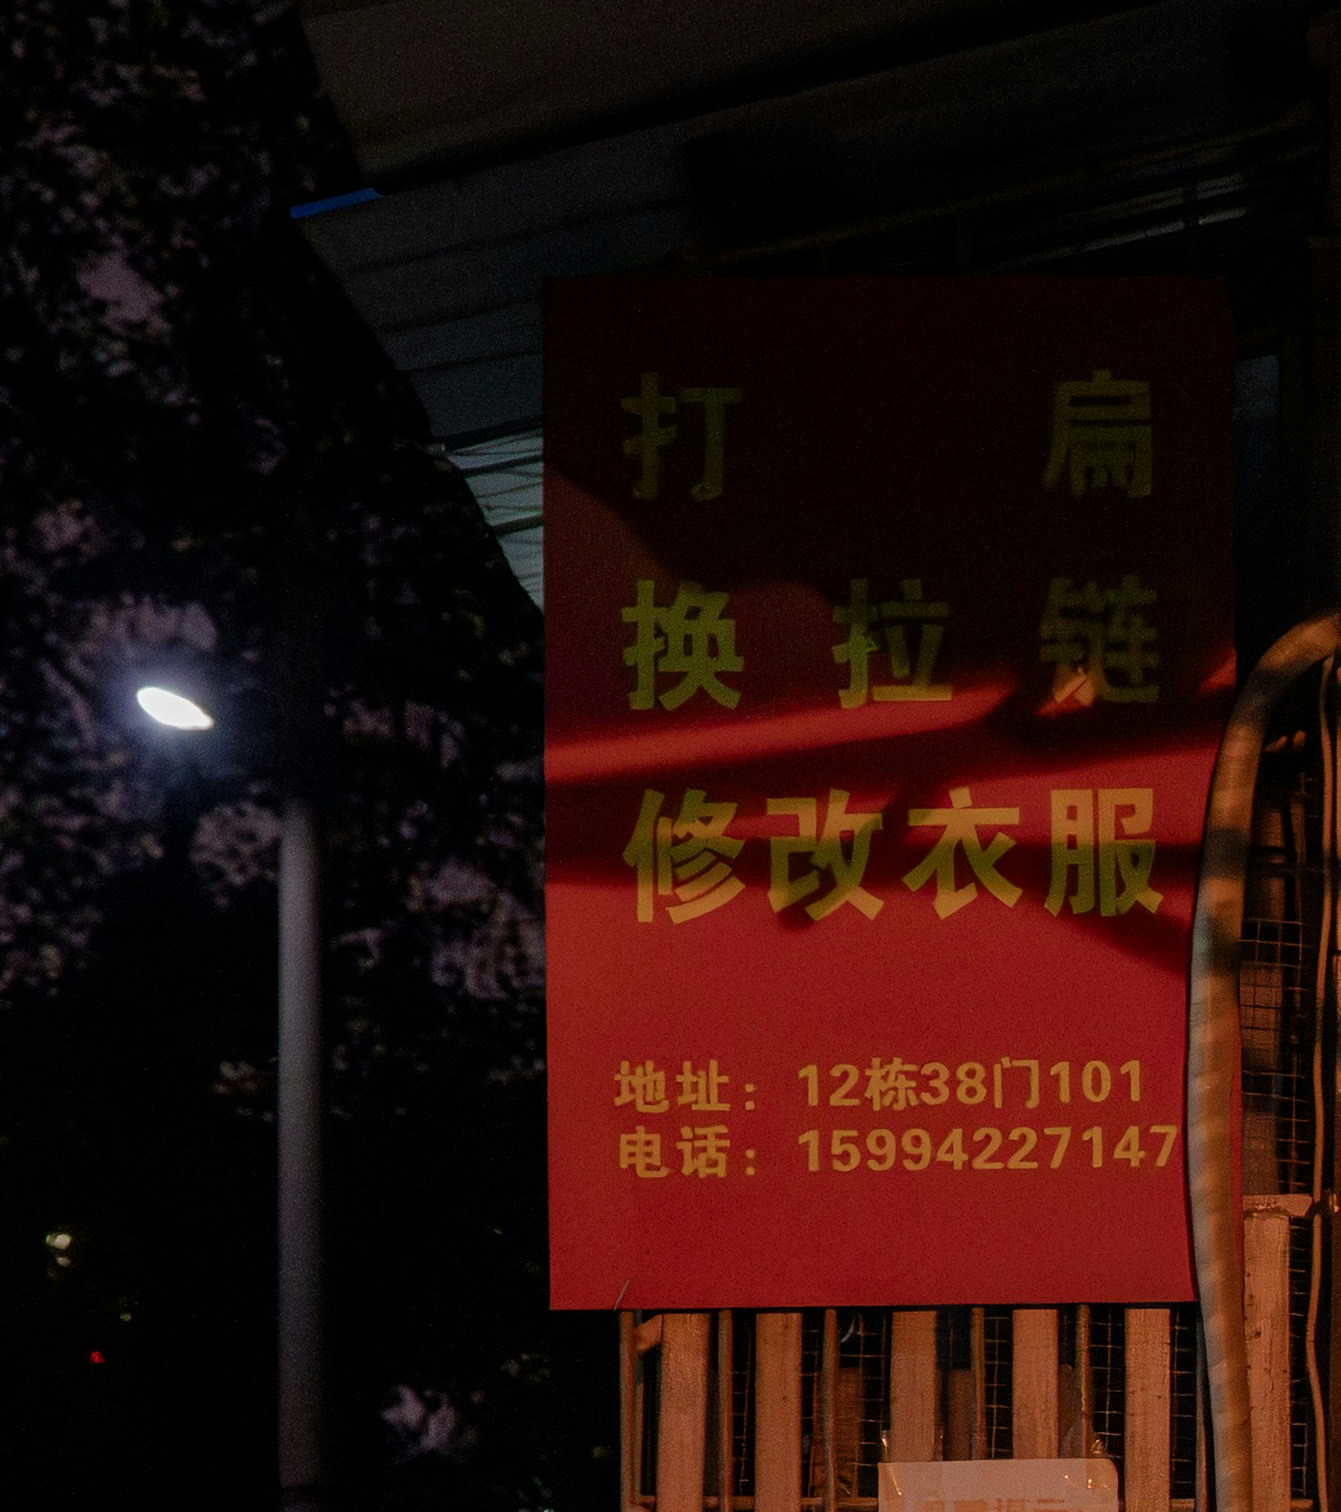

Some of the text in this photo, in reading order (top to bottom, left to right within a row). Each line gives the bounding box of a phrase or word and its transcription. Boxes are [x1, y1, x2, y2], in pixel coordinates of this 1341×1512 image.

[622, 787, 1164, 925] 修改衣服
[797, 1056, 1142, 1112] 12栋38门101
[797, 1124, 1179, 1173] 15994227147
